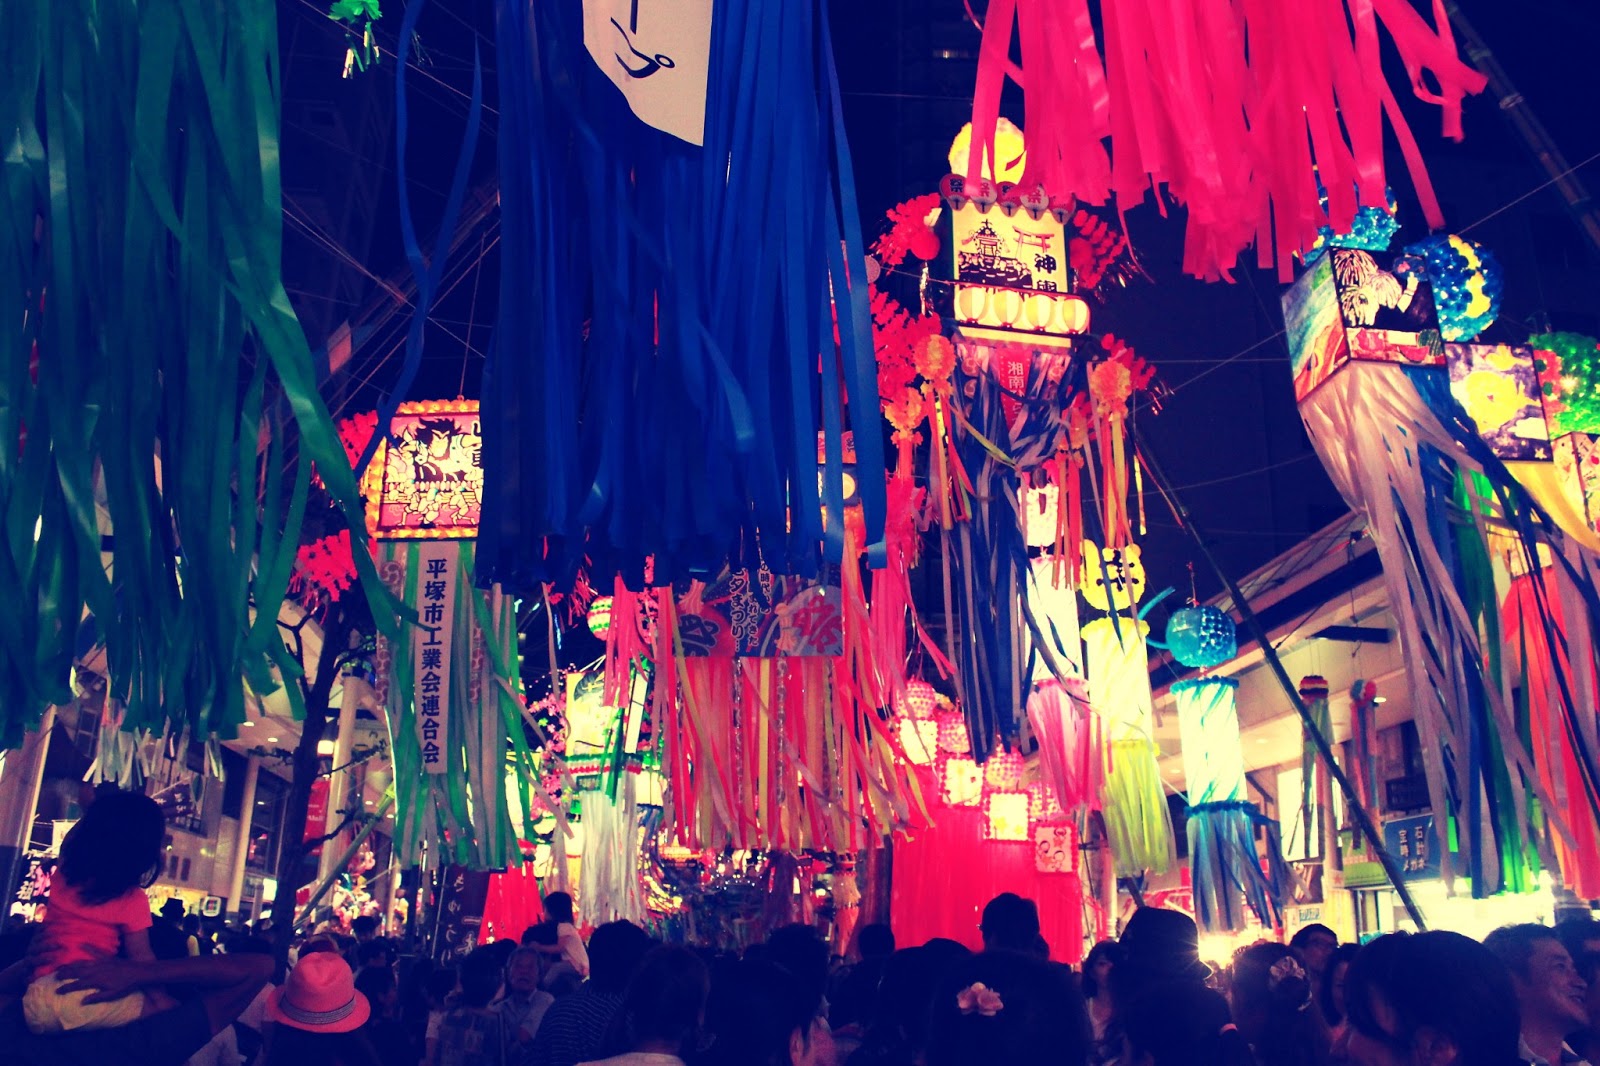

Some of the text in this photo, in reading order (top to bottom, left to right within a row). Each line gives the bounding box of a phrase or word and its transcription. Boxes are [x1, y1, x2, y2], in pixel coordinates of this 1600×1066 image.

[420, 557, 449, 766] 平塚市工業会連合会
